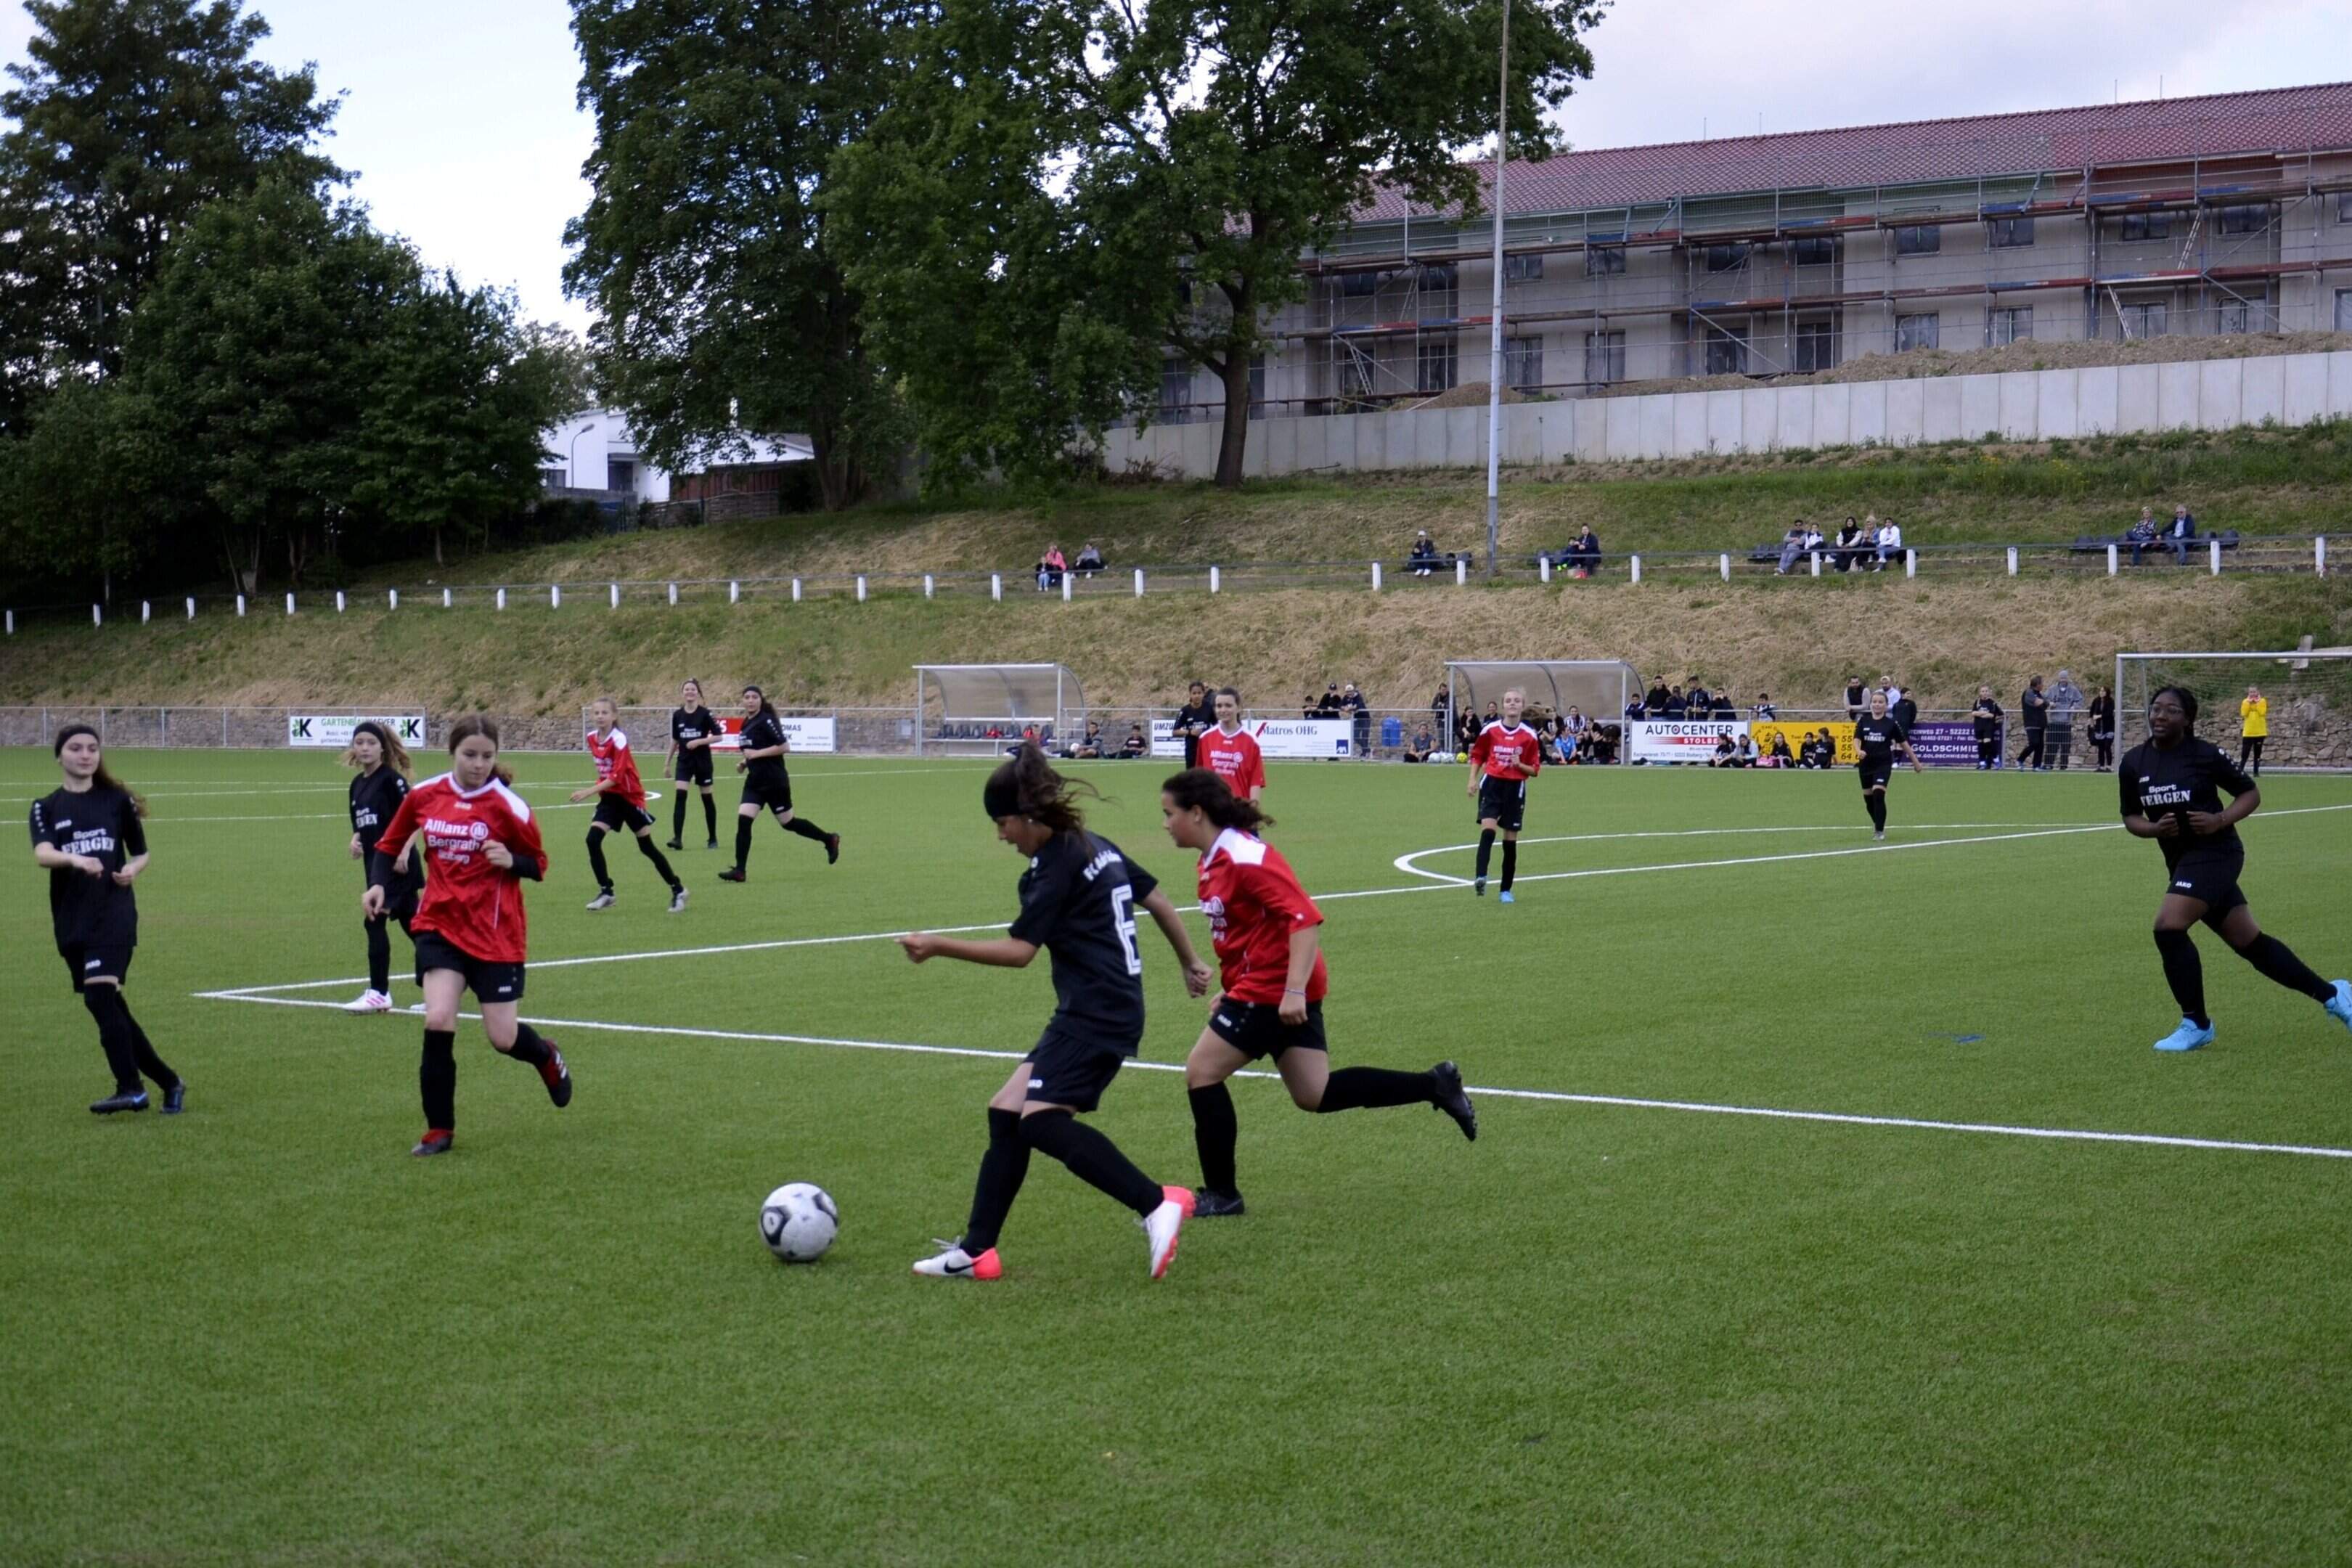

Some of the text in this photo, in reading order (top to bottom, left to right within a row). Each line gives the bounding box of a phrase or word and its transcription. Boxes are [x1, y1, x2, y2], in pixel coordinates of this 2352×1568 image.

[300, 719, 312, 738] K
[407, 719, 421, 738] K
[1263, 726, 1318, 735] Matros OHG
[1646, 724, 1734, 735] AUTOCENTER
[2149, 784, 2177, 793] Sport
[73, 828, 107, 841] Sport
[425, 818, 469, 836] Allianz
[428, 835, 480, 852] Bergrath
